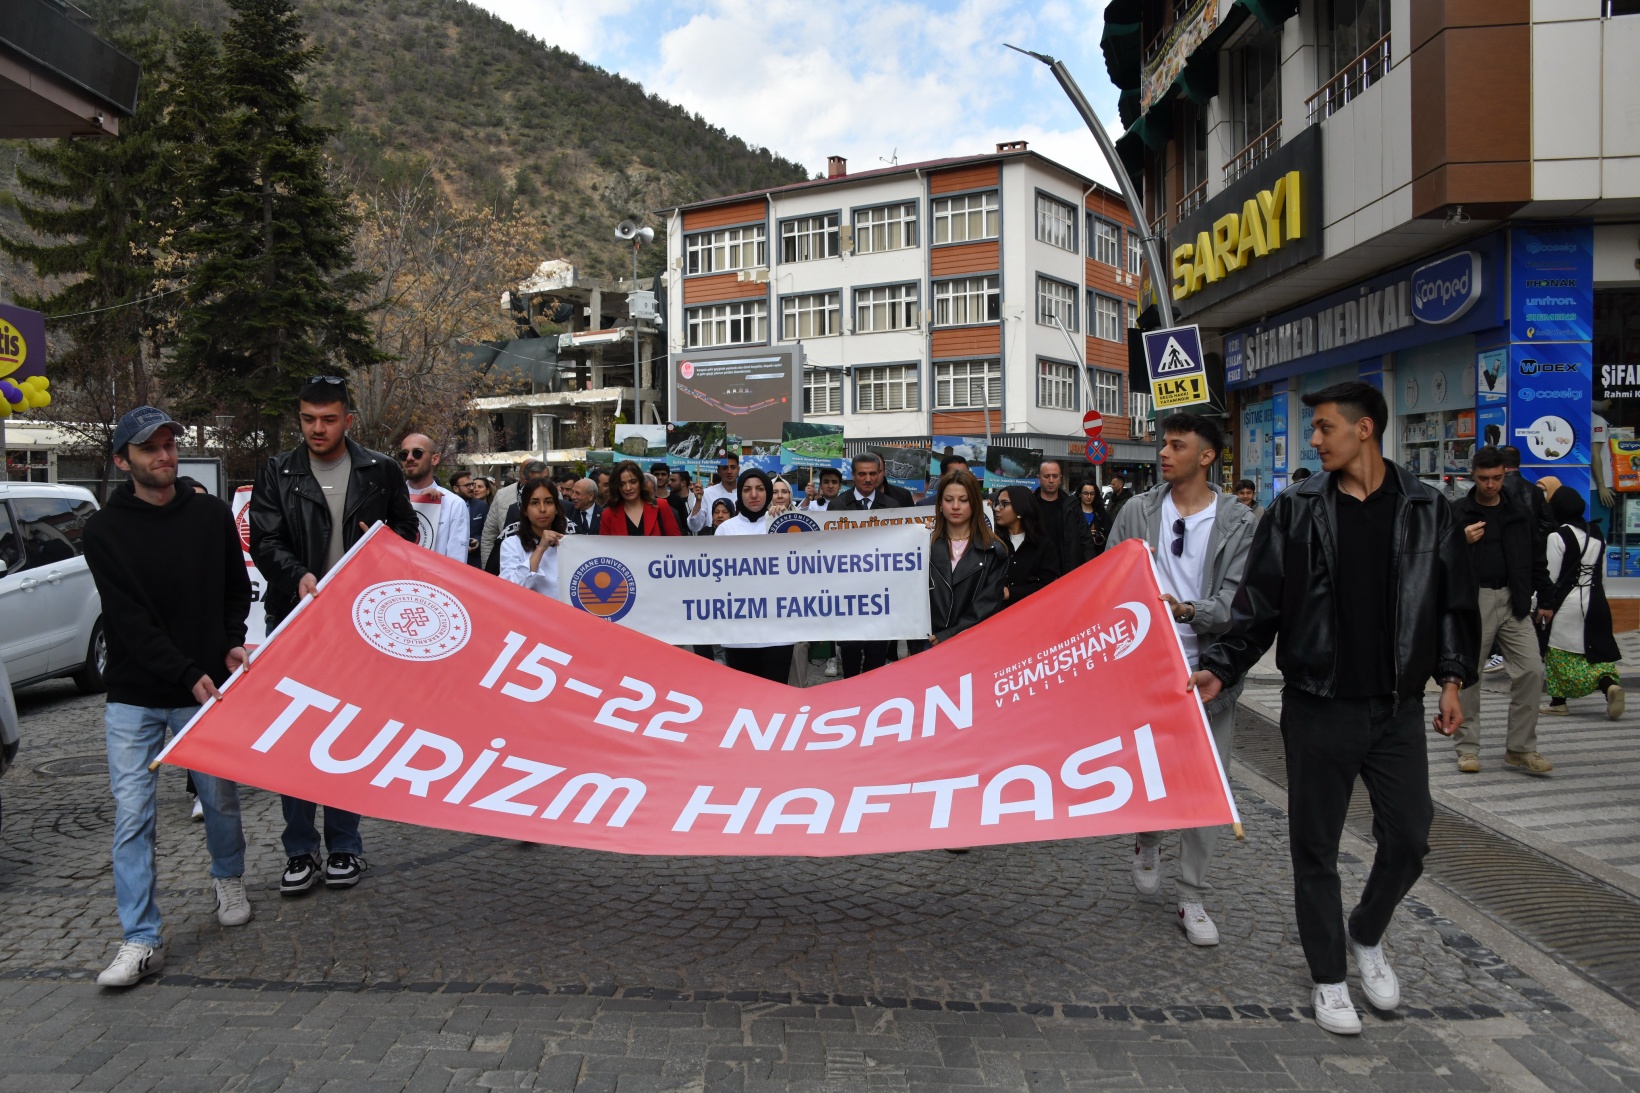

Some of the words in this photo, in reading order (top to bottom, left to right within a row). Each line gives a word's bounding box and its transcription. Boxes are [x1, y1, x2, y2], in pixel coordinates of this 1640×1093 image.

[1172, 171, 1300, 300] SARAYI
[1420, 269, 1468, 305] canped
[1246, 316, 1317, 379] ŞİFAMED
[1318, 281, 1414, 351] MEDİKAL
[1526, 313, 1576, 321] SIEMENS
[1520, 359, 1578, 375] WIDEX
[1158, 380, 1187, 396] İLK
[1536, 388, 1582, 400] coselgi
[1604, 390, 1632, 399] Rahmi
[648, 553, 779, 582] GÜMÜŞHANE
[787, 547, 922, 575] ÜNİVERSİTESİ
[683, 592, 767, 620] TURİZM
[777, 588, 890, 617] FAKÜLTESİ
[994, 657, 1033, 678] TÜRKİYE
[1037, 623, 1101, 660] CUMHURİYETİ
[994, 619, 1130, 696] GÜMÜŞHANE
[479, 630, 703, 743] 15-22
[719, 673, 973, 752] NİSAN
[250, 676, 647, 828] TURİZM
[671, 723, 1167, 835] HAFTASI
